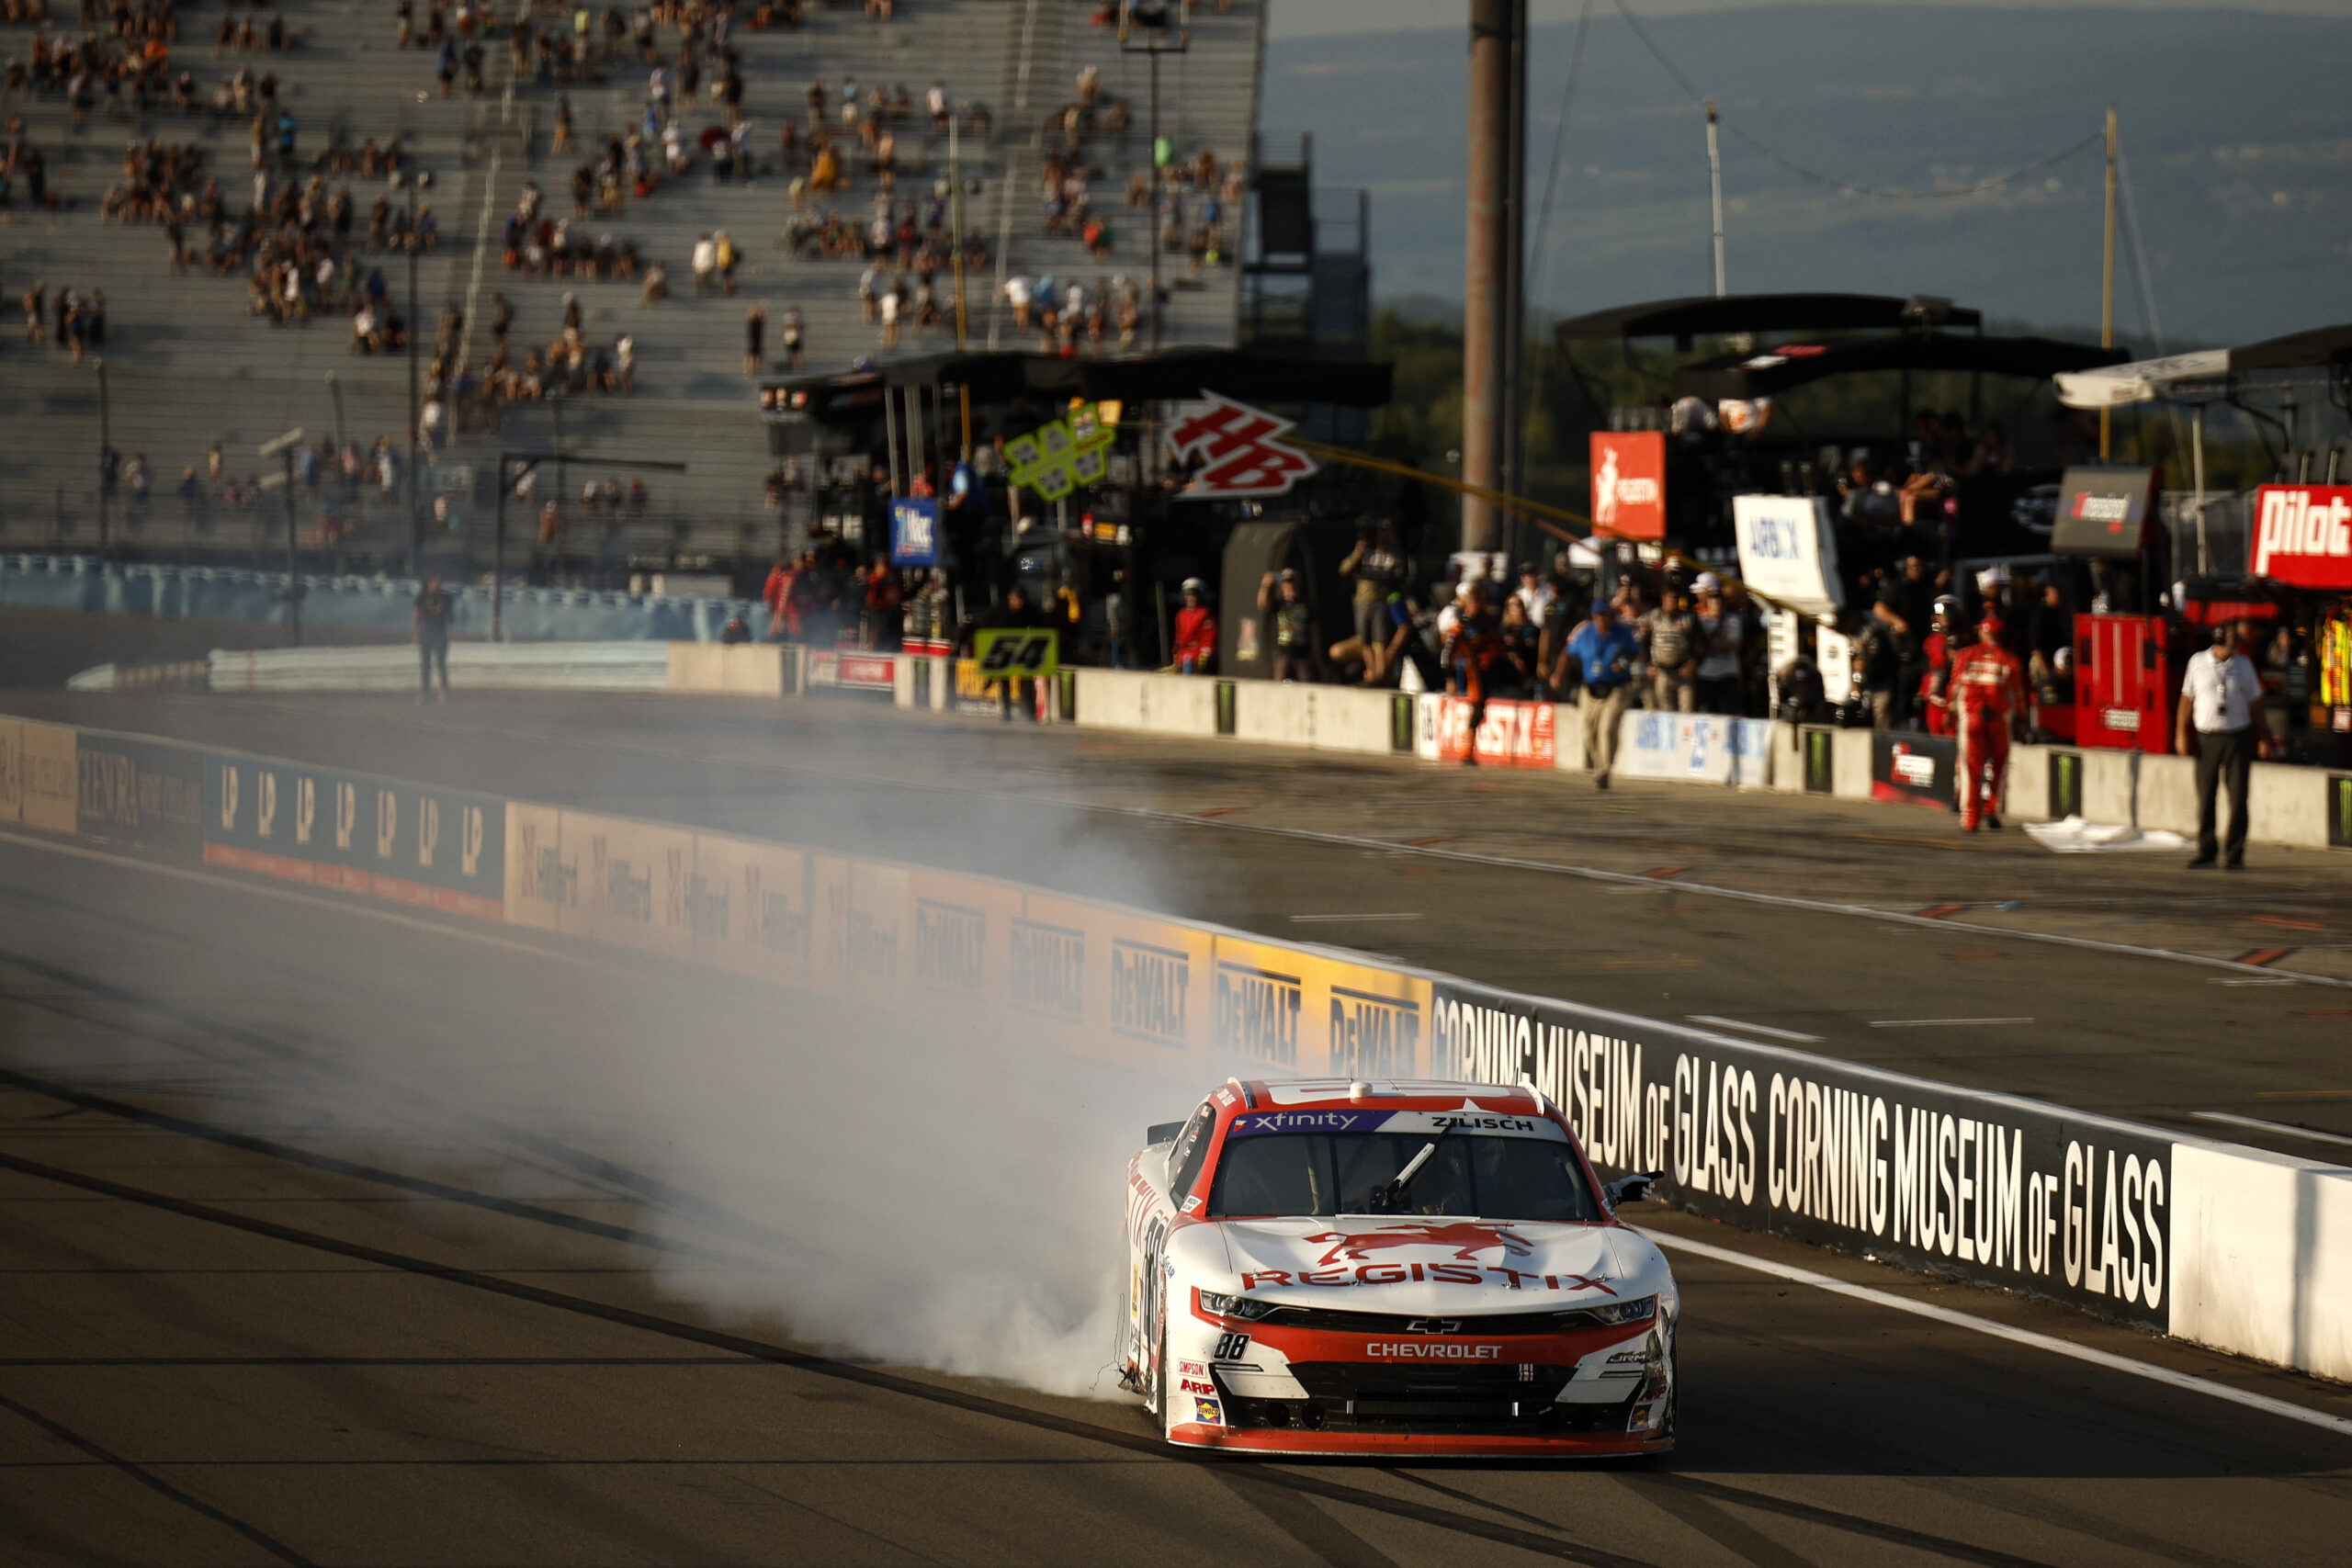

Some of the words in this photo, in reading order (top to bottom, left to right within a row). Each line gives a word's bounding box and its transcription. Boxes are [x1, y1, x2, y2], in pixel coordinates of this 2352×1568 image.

[980, 636, 1052, 671] 54
[1254, 1112, 1359, 1133] xfinity
[1535, 1021, 1643, 1173] MUSEUM
[1645, 1081, 1671, 1173] OF
[1673, 1053, 1758, 1206] GLASS
[1767, 1072, 1888, 1237] CORNING
[1894, 1103, 2021, 1272] MUSEUM
[2028, 1171, 2058, 1276] OF
[2064, 1140, 2165, 1310] GLASS
[1240, 1263, 1618, 1298] REGISTIX
[1213, 1333, 1251, 1360] 88
[1366, 1343, 1502, 1359] CHEVROLET
[1179, 1360, 1204, 1376] SIMPSON
[1181, 1378, 1216, 1394] ARP
[1198, 1406, 1220, 1416] SUNOCO
